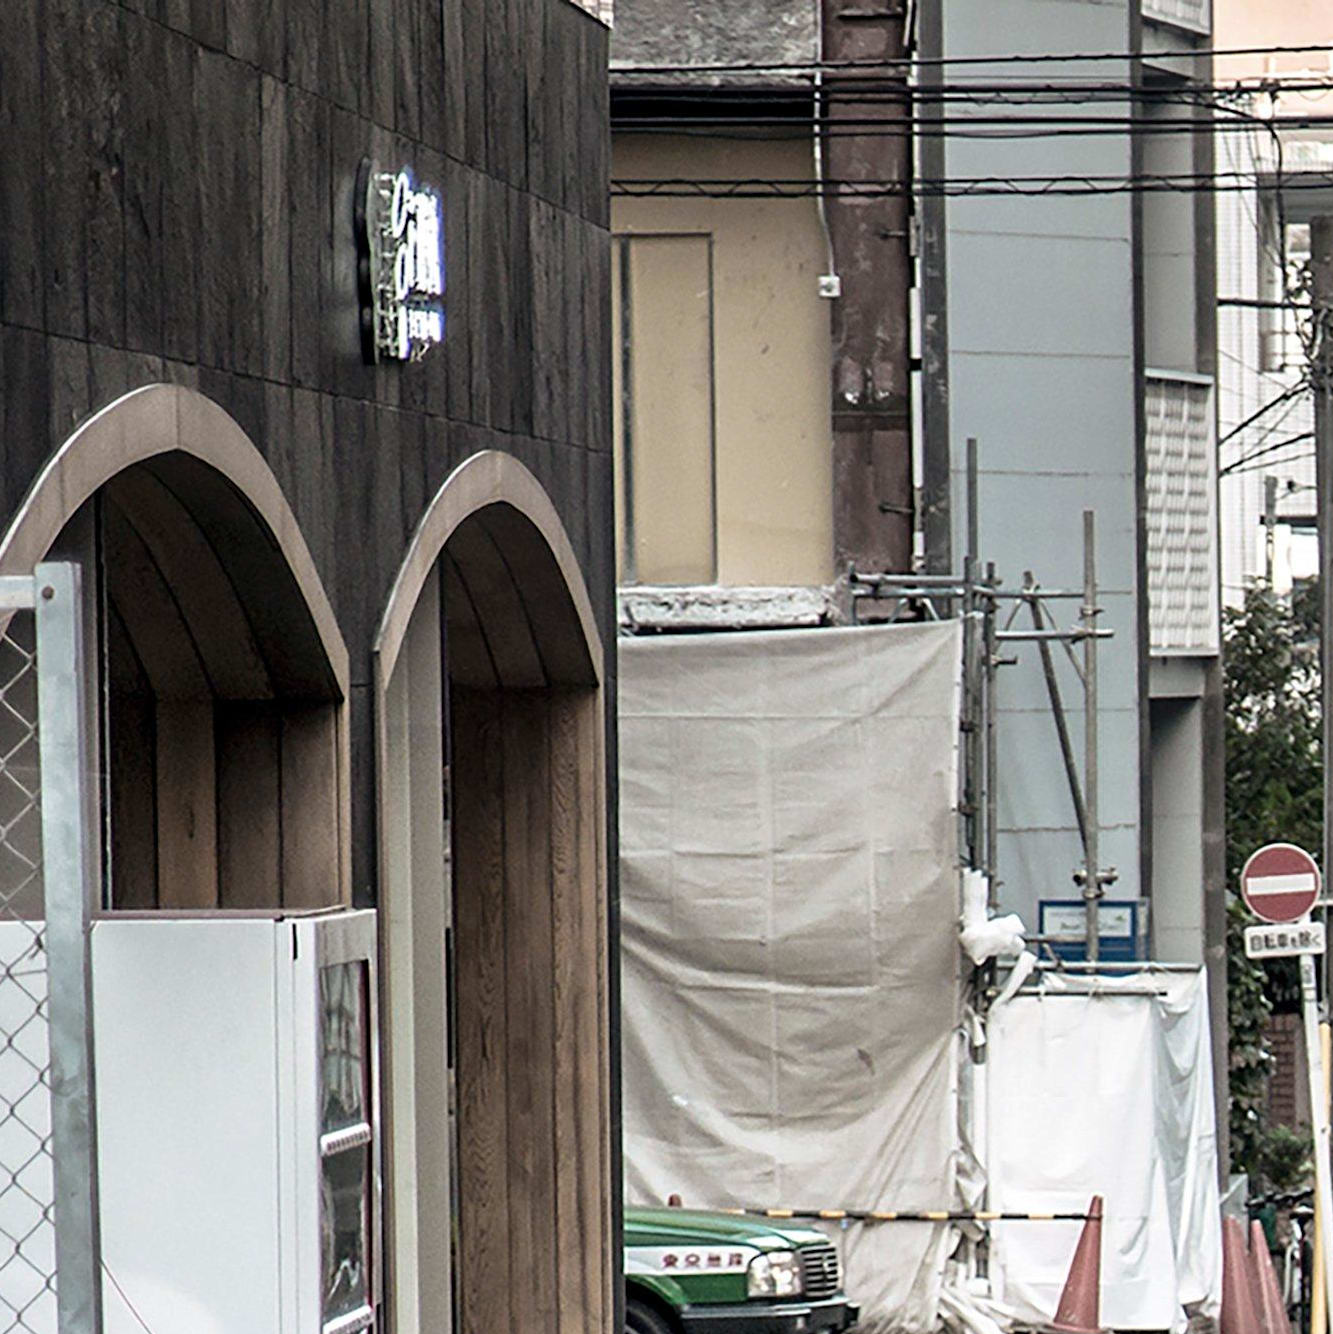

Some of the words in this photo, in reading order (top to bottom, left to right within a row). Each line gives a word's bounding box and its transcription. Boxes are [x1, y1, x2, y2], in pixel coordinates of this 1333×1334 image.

[1250, 930, 1322, 952] 自転車を除く
[662, 1252, 744, 1269] 東京無線
